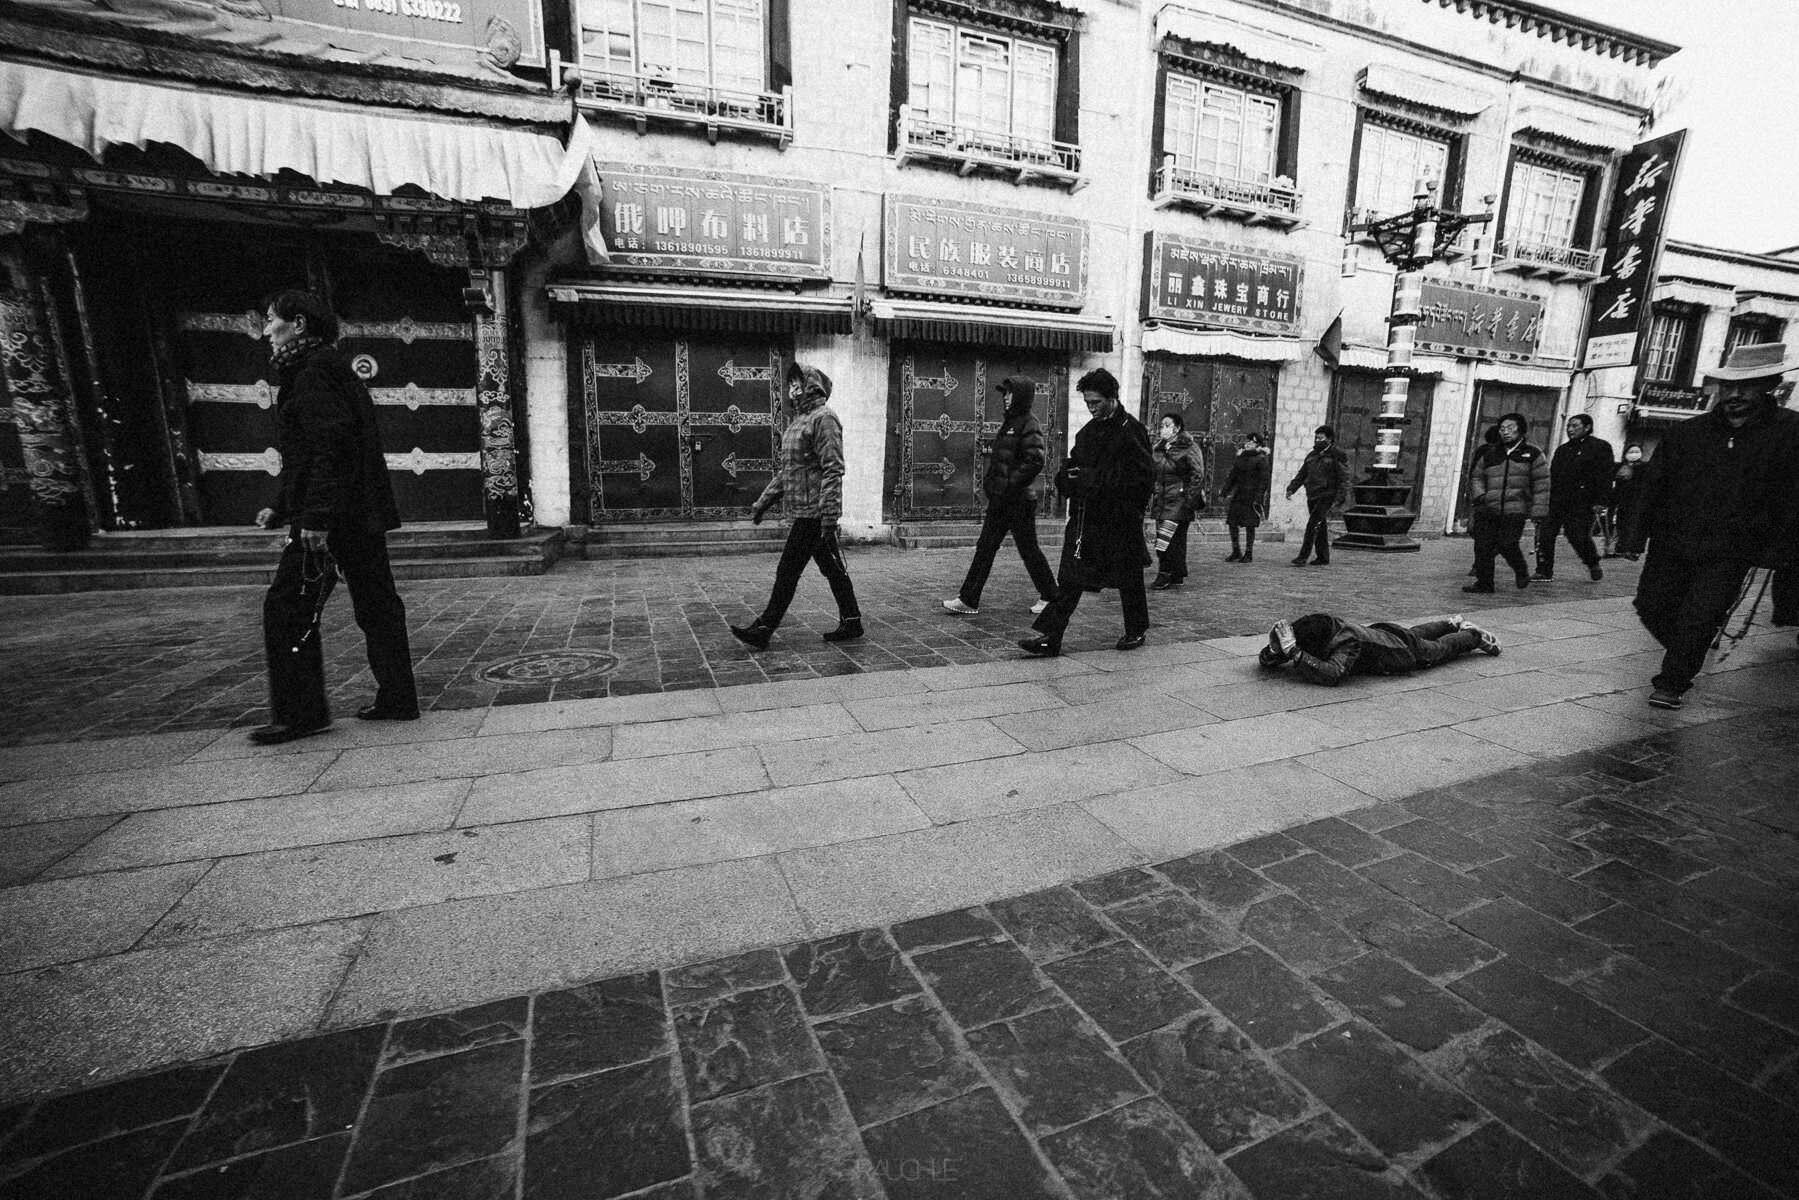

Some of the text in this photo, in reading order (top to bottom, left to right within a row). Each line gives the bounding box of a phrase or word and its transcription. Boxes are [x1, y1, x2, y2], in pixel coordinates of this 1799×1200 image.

[908, 235, 1072, 275] 民族服装商店
[1167, 296, 1289, 321] LI XIN JEWERY STORE
[1168, 272, 1290, 309] 丽鑫珠宝商行
